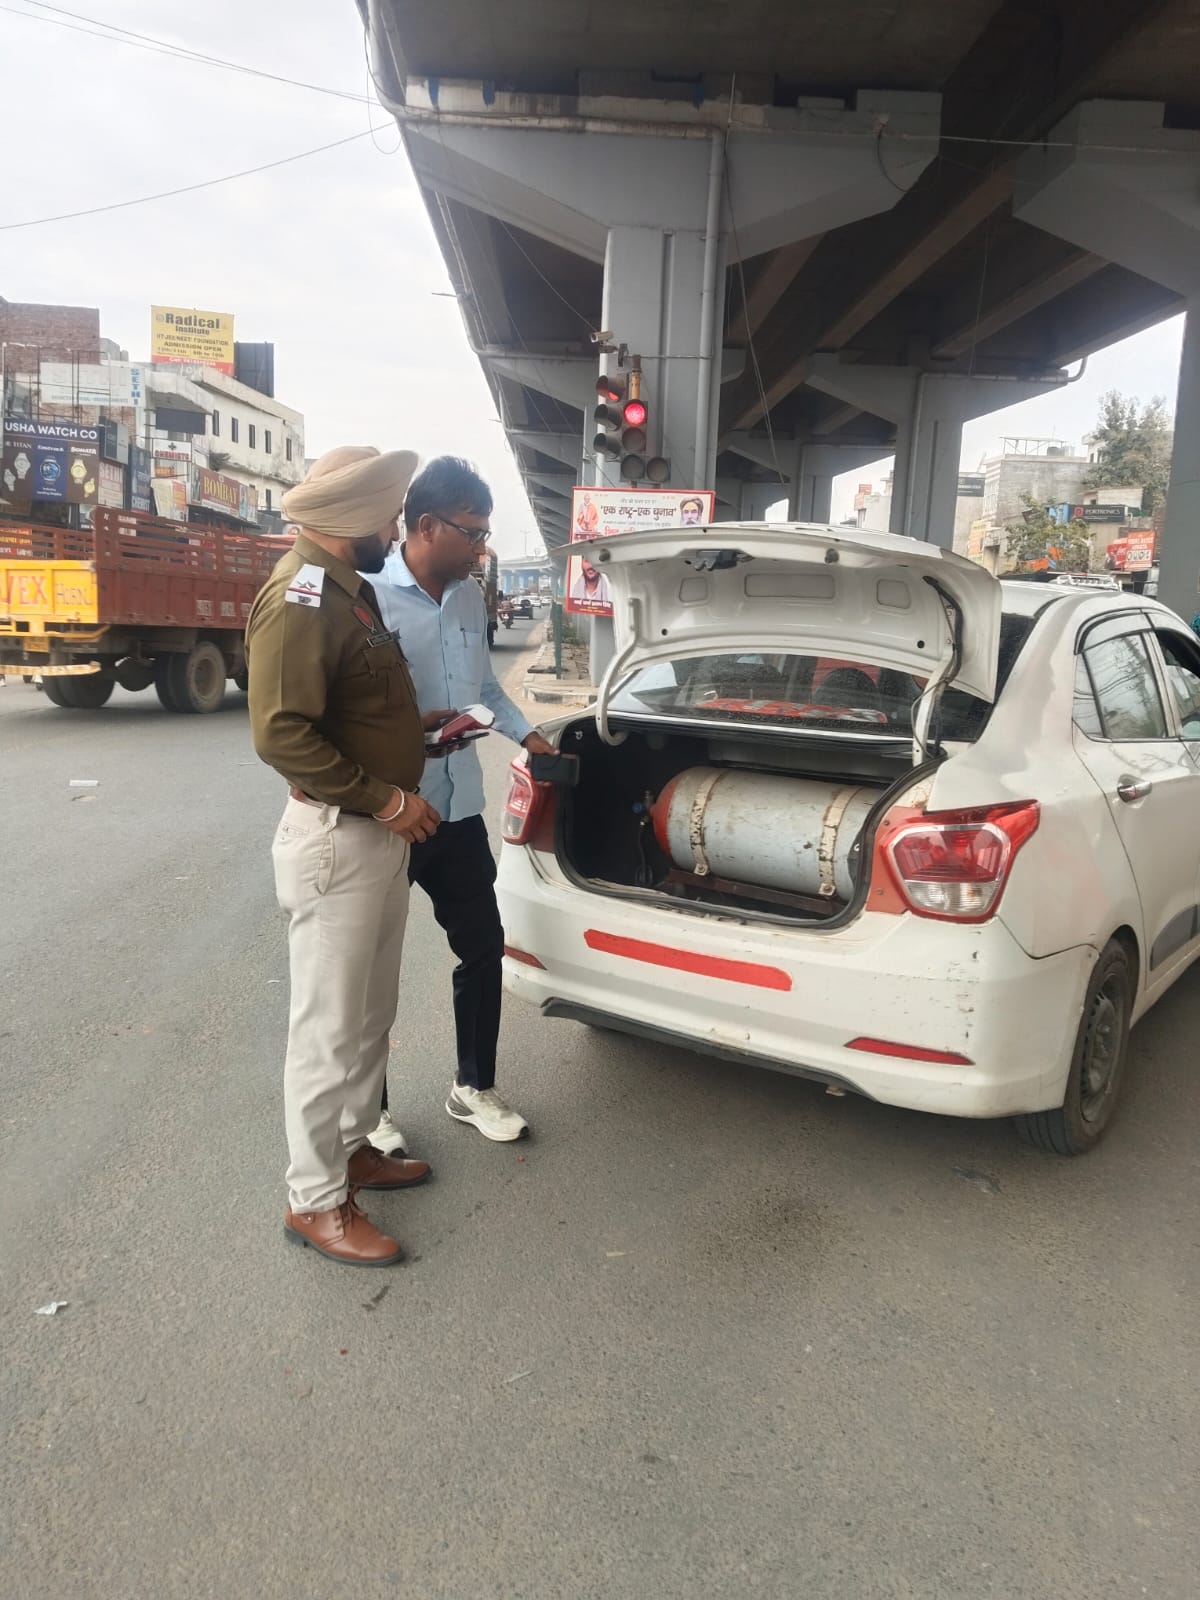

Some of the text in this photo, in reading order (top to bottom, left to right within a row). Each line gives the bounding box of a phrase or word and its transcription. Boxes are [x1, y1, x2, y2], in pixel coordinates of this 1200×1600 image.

[166, 313, 220, 329] Radical
[176, 325, 210, 335] Institute
[164, 341, 202, 350] ADMISSION
[5, 422, 97, 440] USHA WATCH CO
[13, 441, 32, 449] TITAN
[203, 475, 237, 505] BOMBAY
